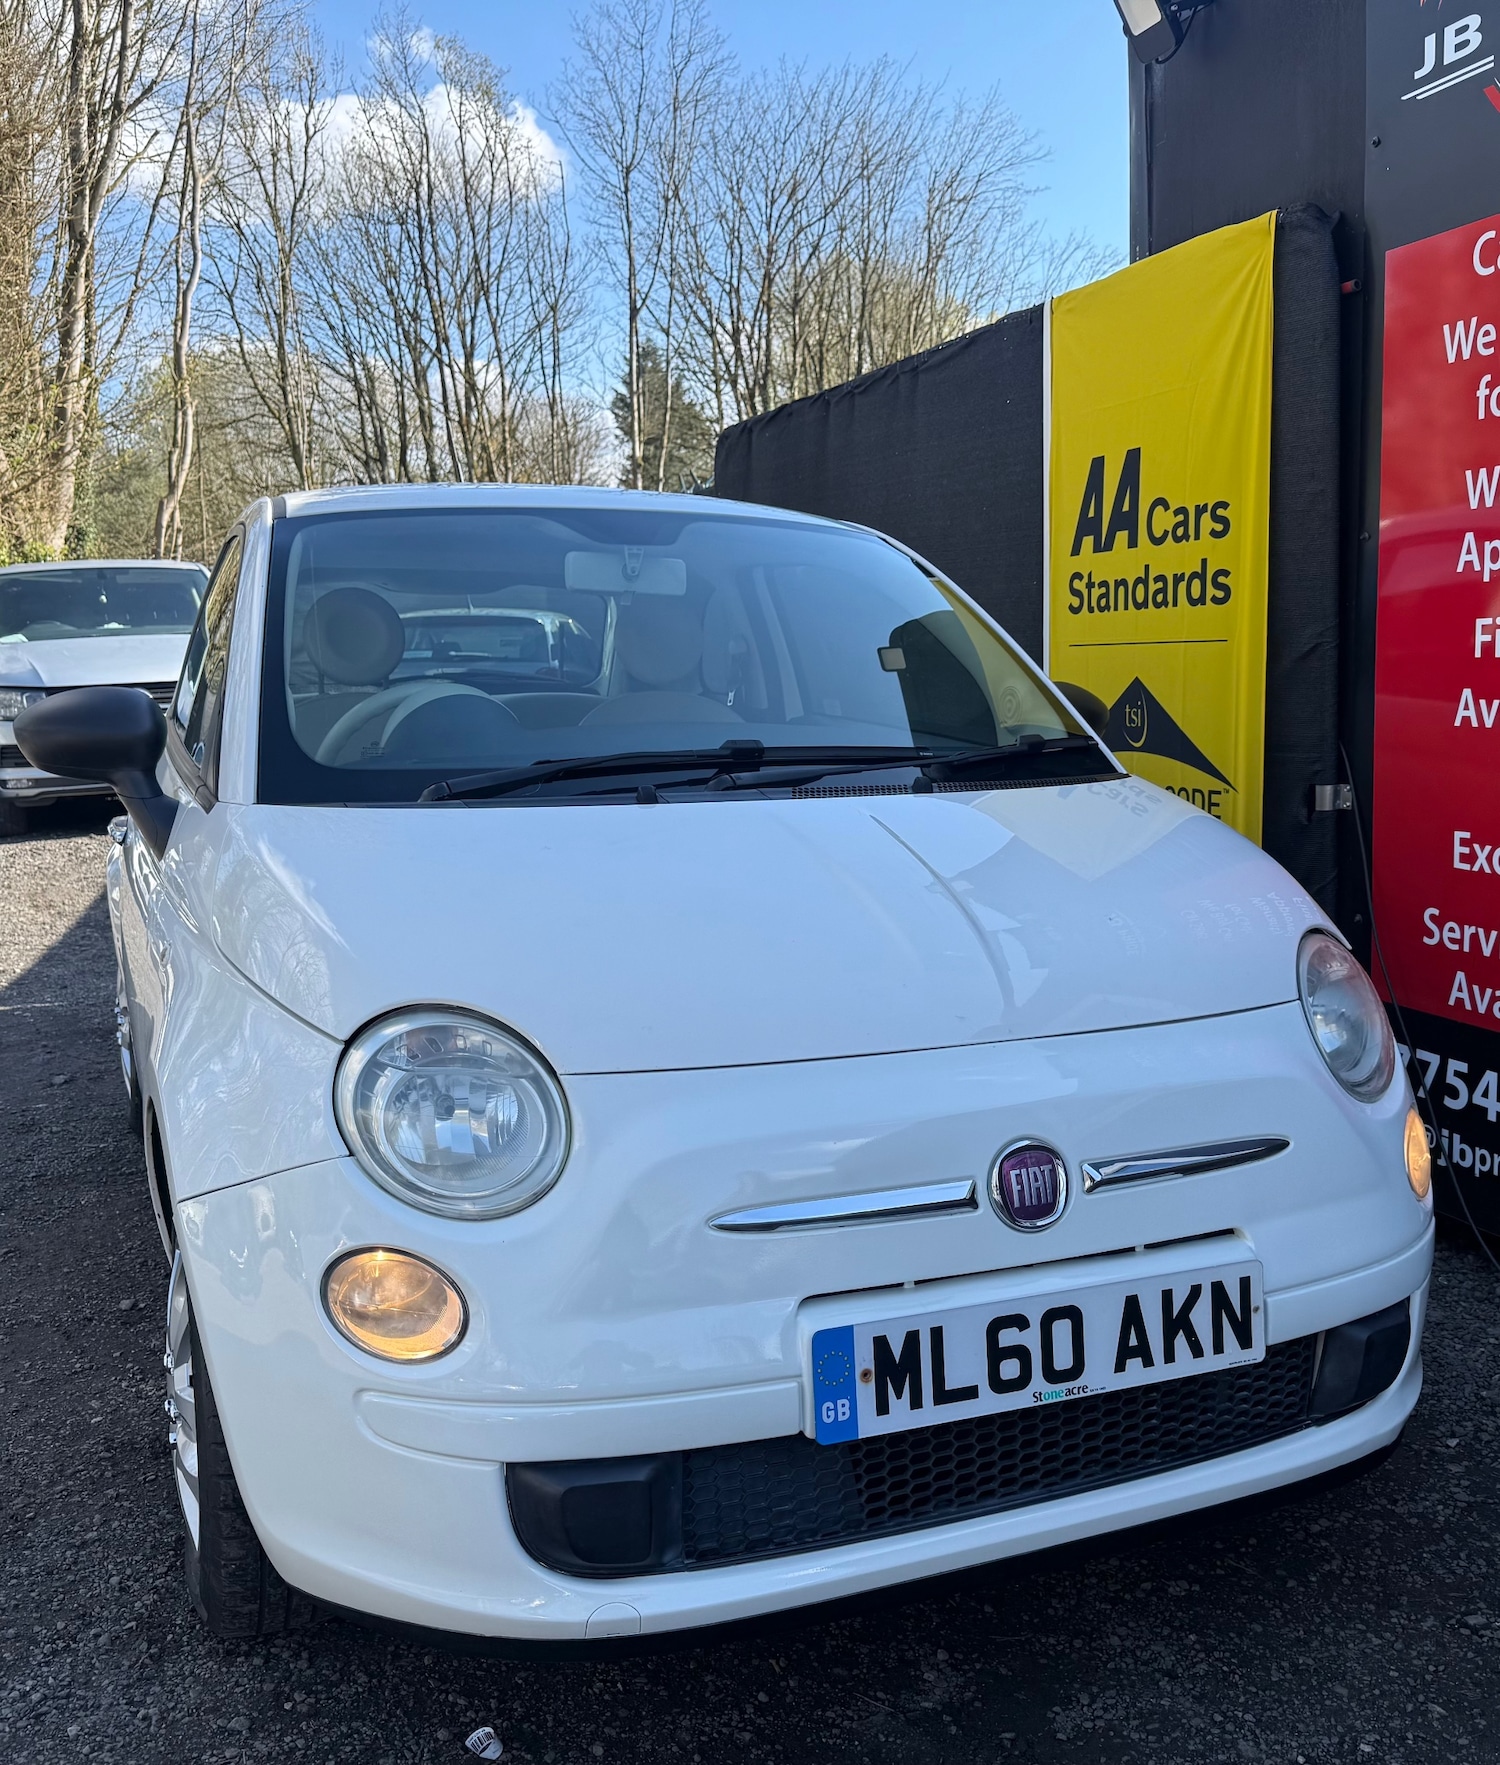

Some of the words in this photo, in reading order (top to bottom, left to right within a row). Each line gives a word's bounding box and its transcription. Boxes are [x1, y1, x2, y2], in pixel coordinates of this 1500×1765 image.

[1414, 13, 1483, 80] JB
[1472, 230, 1500, 276] C
[1443, 316, 1497, 364] We
[1070, 447, 1141, 557] AA
[1146, 497, 1231, 546] Cars
[1456, 531, 1500, 582] Ap
[1068, 558, 1232, 615] Standards
[1125, 701, 1141, 727] tsi
[1454, 688, 1500, 728] Av
[1010, 1164, 1053, 1208] FIAT
[872, 1304, 1085, 1417] ML60
[1113, 1276, 1253, 1374] AKN
[821, 1399, 850, 1424] GB
[1032, 1384, 1089, 1403] Stoneacre
